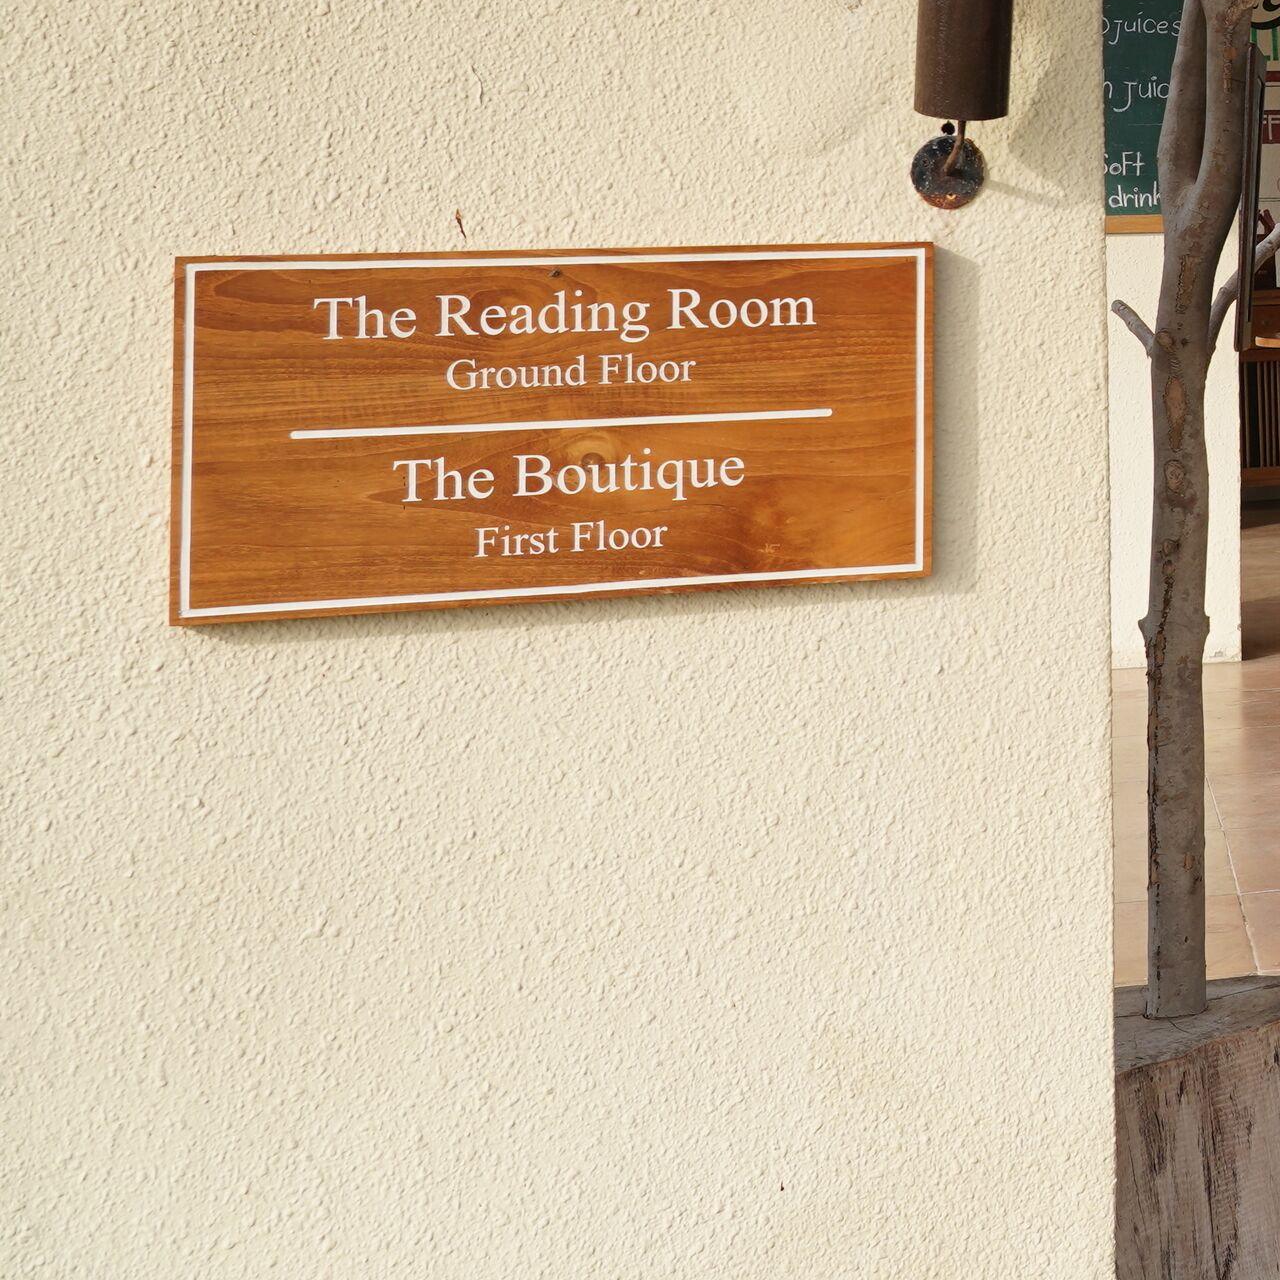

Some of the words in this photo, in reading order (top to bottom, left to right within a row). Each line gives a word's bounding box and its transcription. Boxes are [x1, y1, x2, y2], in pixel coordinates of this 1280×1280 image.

[313, 293, 417, 340] The
[434, 289, 650, 343] Reading
[666, 287, 817, 329] Room
[446, 354, 586, 390] Ground
[598, 353, 697, 385] Floor
[393, 456, 495, 502] The
[512, 447, 745, 501] Boutique
[474, 524, 559, 557] First
[570, 520, 669, 552] Floor
